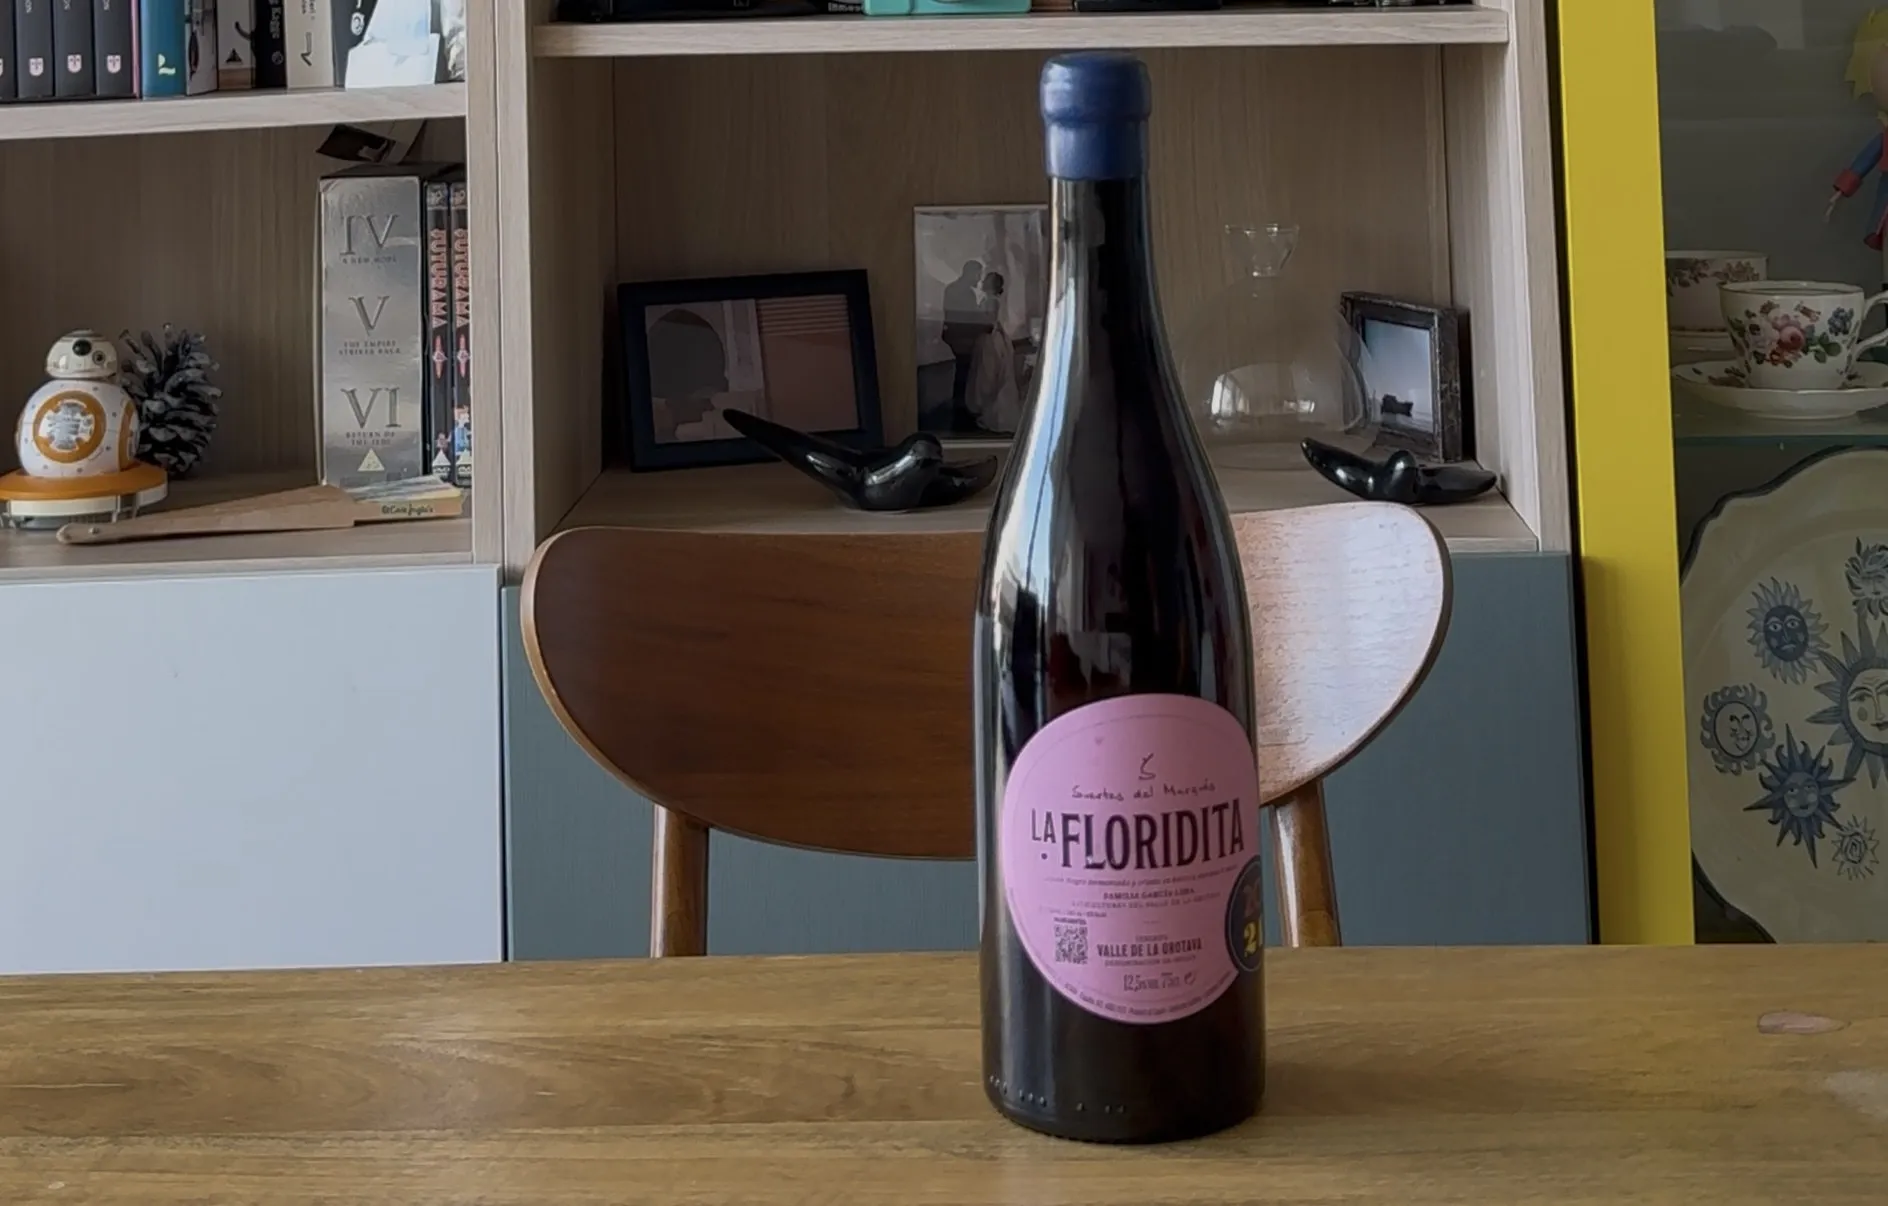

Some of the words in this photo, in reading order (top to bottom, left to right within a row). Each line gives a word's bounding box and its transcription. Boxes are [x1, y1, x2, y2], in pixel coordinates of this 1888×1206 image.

[340, 213, 399, 255] IV
[430, 228, 447, 328] FUTURAMA
[348, 295, 390, 336] V
[340, 387, 401, 429] VI
[1071, 784, 1124, 802] Suertes
[1133, 784, 1154, 799] del
[1031, 808, 1057, 843] LA
[1061, 798, 1245, 869] FLORIDITA
[1096, 943, 1128, 957] VALLE
[1130, 943, 1144, 957] DE
[1147, 943, 1159, 956] LA
[1162, 937, 1203, 955] OROTAVA
